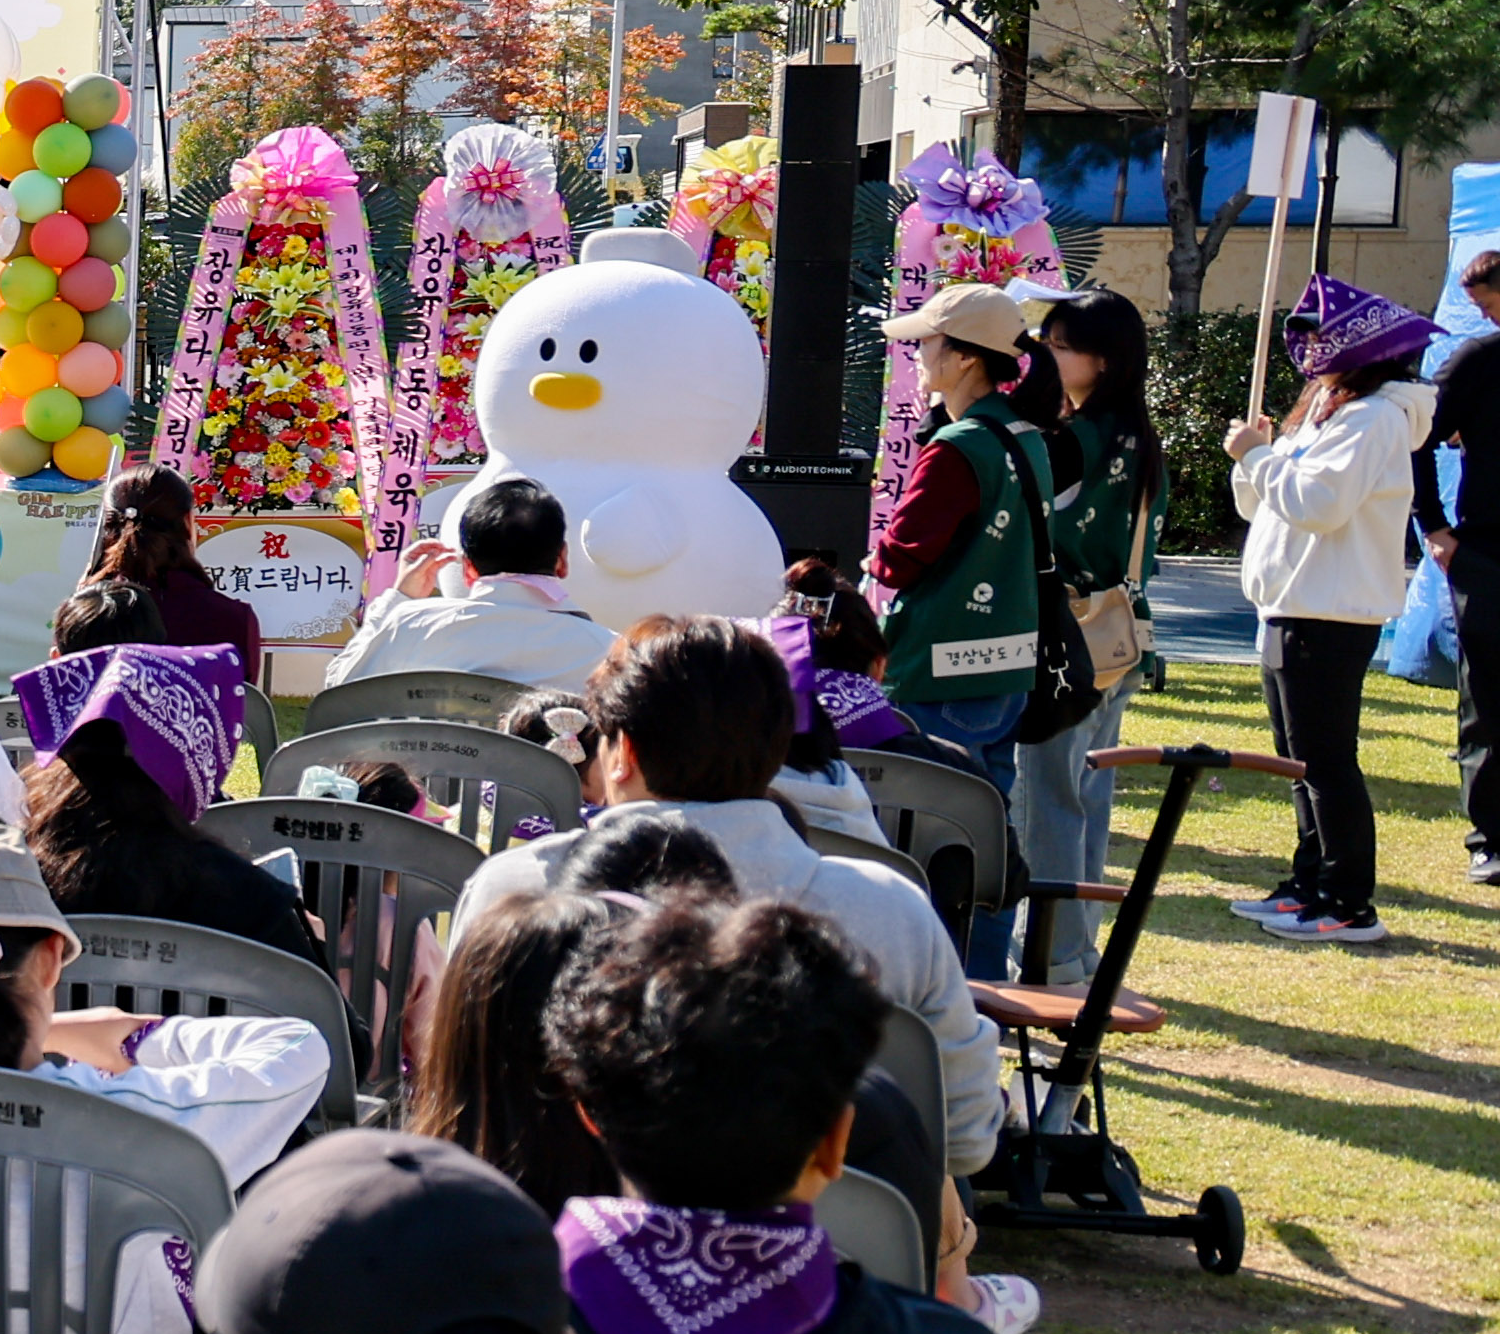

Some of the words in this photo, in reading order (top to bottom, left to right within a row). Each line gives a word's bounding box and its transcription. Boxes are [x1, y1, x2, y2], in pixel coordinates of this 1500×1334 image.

[774, 465, 853, 475] AUDIOTECHNIK
[17, 491, 53, 506] GIM
[258, 531, 291, 560] 祝
[944, 646, 1008, 667] 경상남도
[430, 741, 479, 758] 295-4500
[81, 934, 152, 962] 합렌탈
[156, 940, 178, 964] 원
